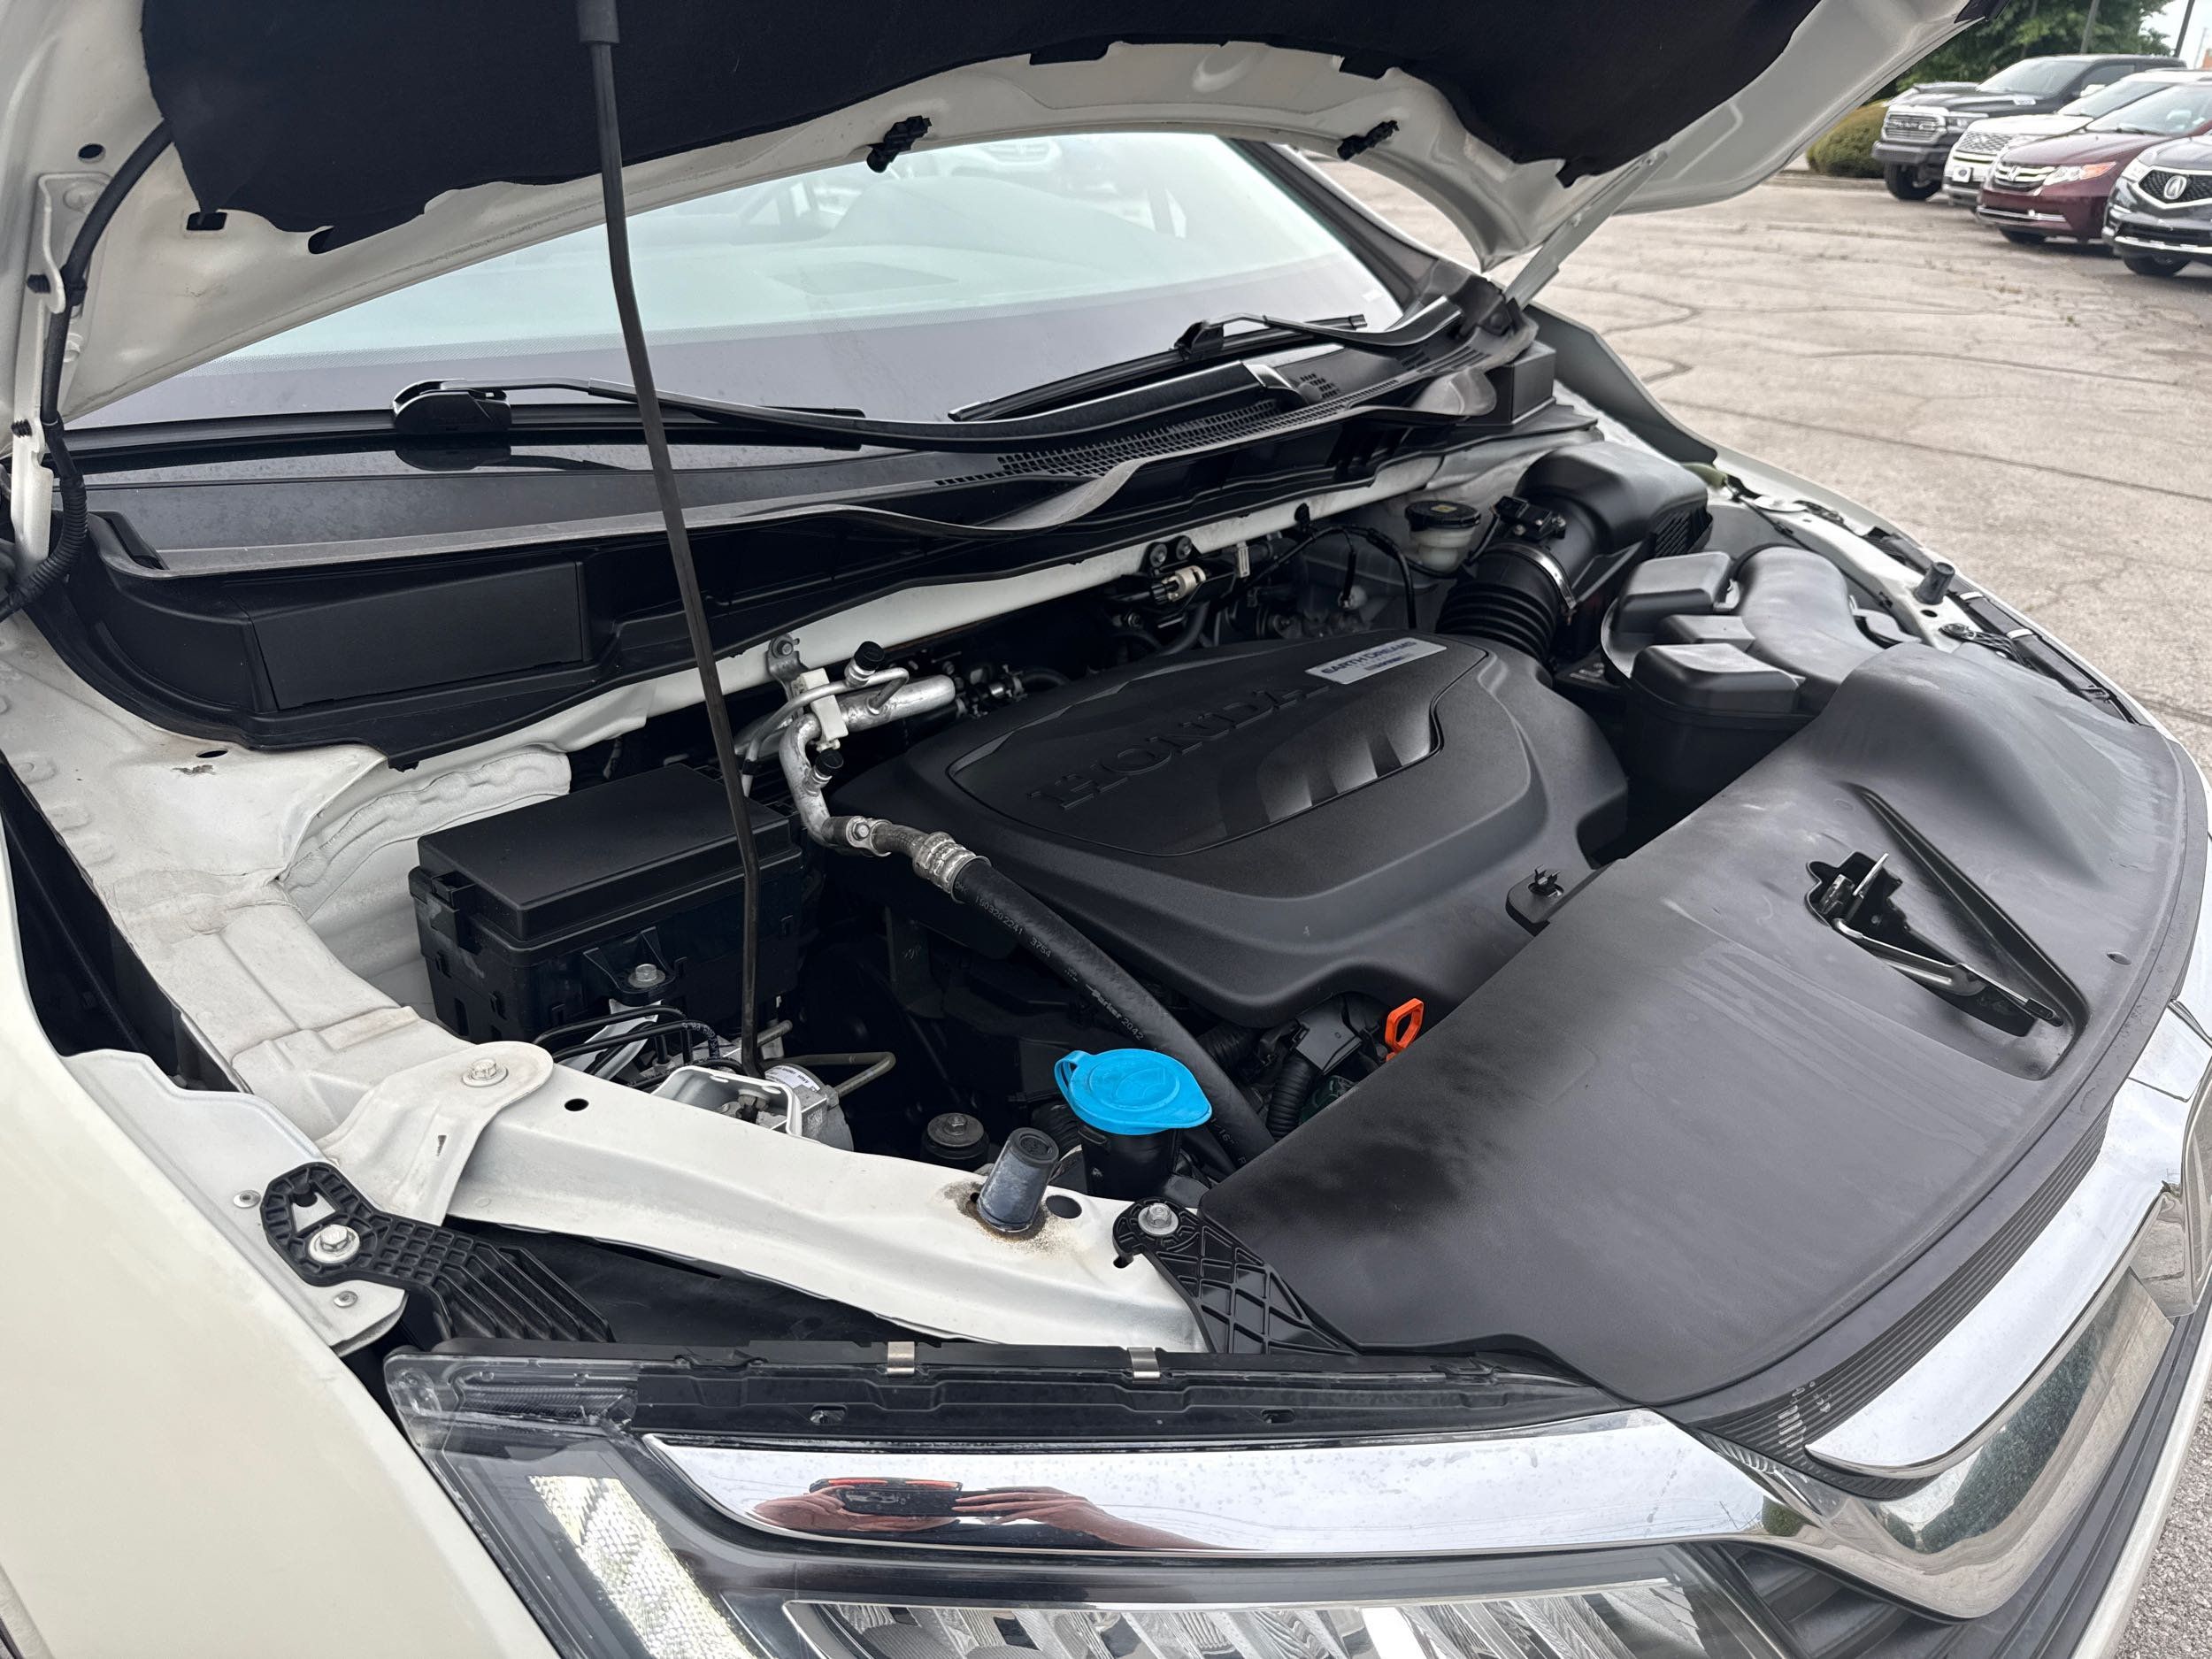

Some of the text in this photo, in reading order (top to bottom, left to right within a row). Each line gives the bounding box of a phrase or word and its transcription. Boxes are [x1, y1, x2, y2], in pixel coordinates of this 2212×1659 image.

[1321, 654, 1368, 673] EARTH
[1365, 641, 1417, 659] DREAMS
[1027, 687, 1328, 810] HONDA
[1030, 937, 1051, 957] 3754
[1088, 987, 1122, 1019] Parker
[1121, 1018, 1144, 1041] 2042
